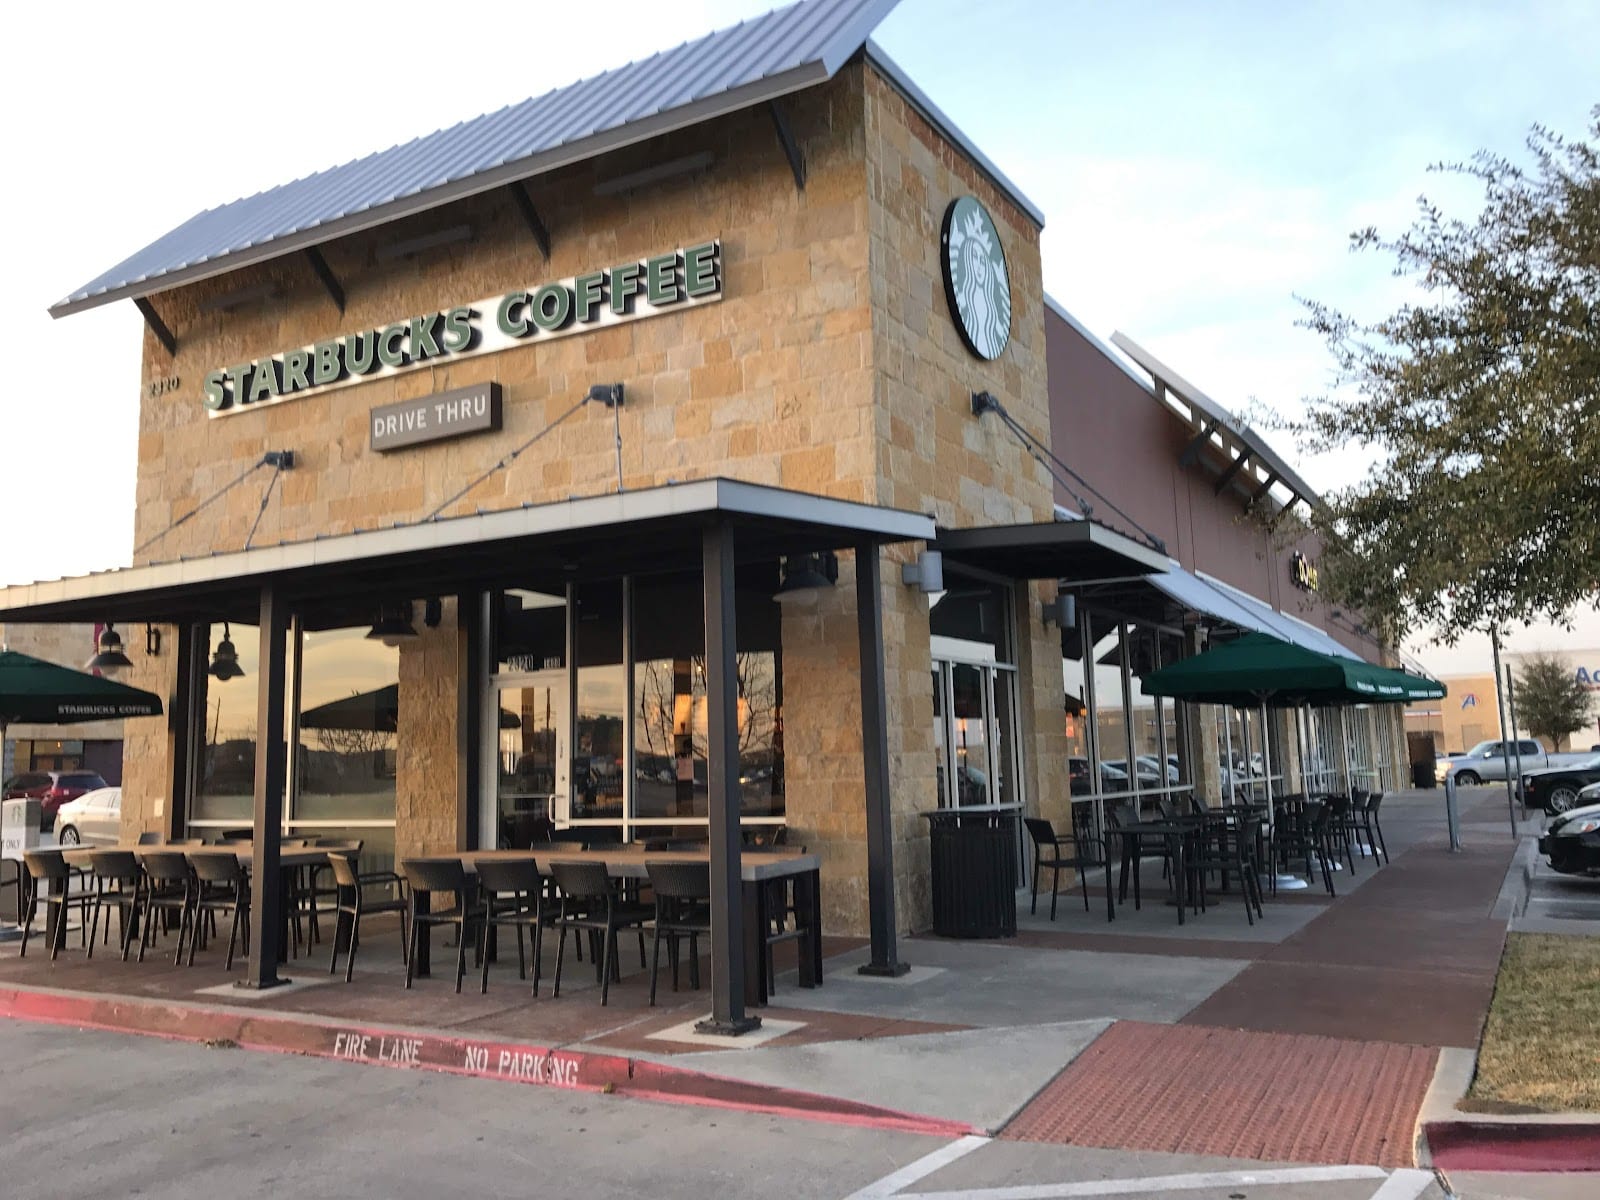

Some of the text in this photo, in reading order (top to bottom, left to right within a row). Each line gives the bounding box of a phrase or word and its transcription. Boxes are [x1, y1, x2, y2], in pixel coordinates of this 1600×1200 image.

[203, 241, 716, 411] STARBUCKS COFFEE
[374, 394, 486, 438] DRIVE THRU
[333, 1033, 424, 1065] FIRE LANE
[464, 1045, 489, 1072] NO
